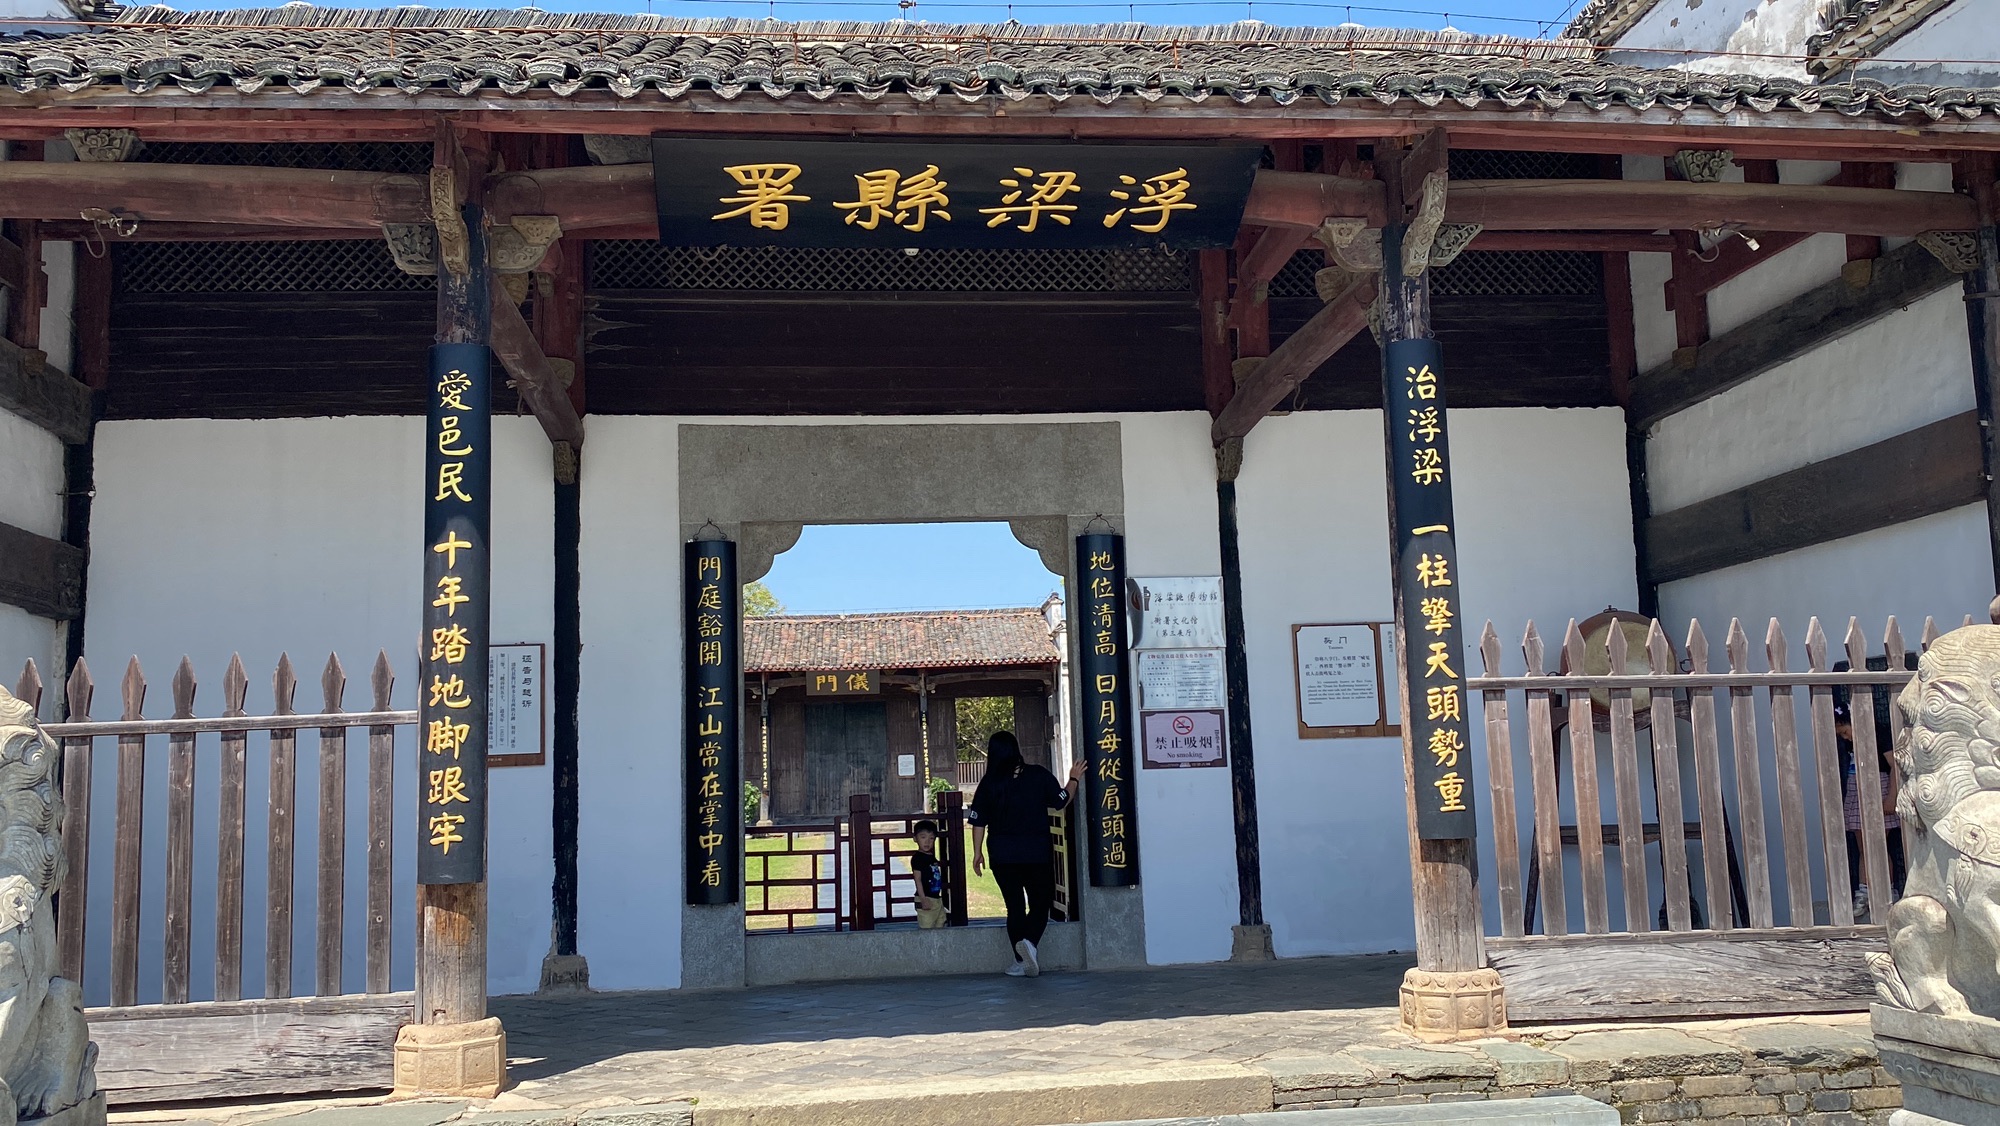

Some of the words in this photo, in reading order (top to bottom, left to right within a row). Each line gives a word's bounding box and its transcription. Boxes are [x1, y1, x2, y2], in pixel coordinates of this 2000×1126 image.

[712, 163, 1198, 233] 浮梁縣署
[435, 370, 473, 503] 愛邑民
[1406, 366, 1443, 486] 治浮梁
[698, 556, 723, 667] 門庭豁開
[1089, 550, 1117, 656] 地位清高
[427, 532, 473, 854] 十年踏地脚跟牢
[815, 672, 870, 693] 儀門
[1411, 523, 1466, 815] 一柱擎天頭勢重
[698, 686, 724, 887] 江山常在掌中看
[1095, 674, 1127, 868] 日月每從肩頭過
[1154, 735, 1213, 751] 禁止吸烟
[1176, 751, 1203, 760] smoking
